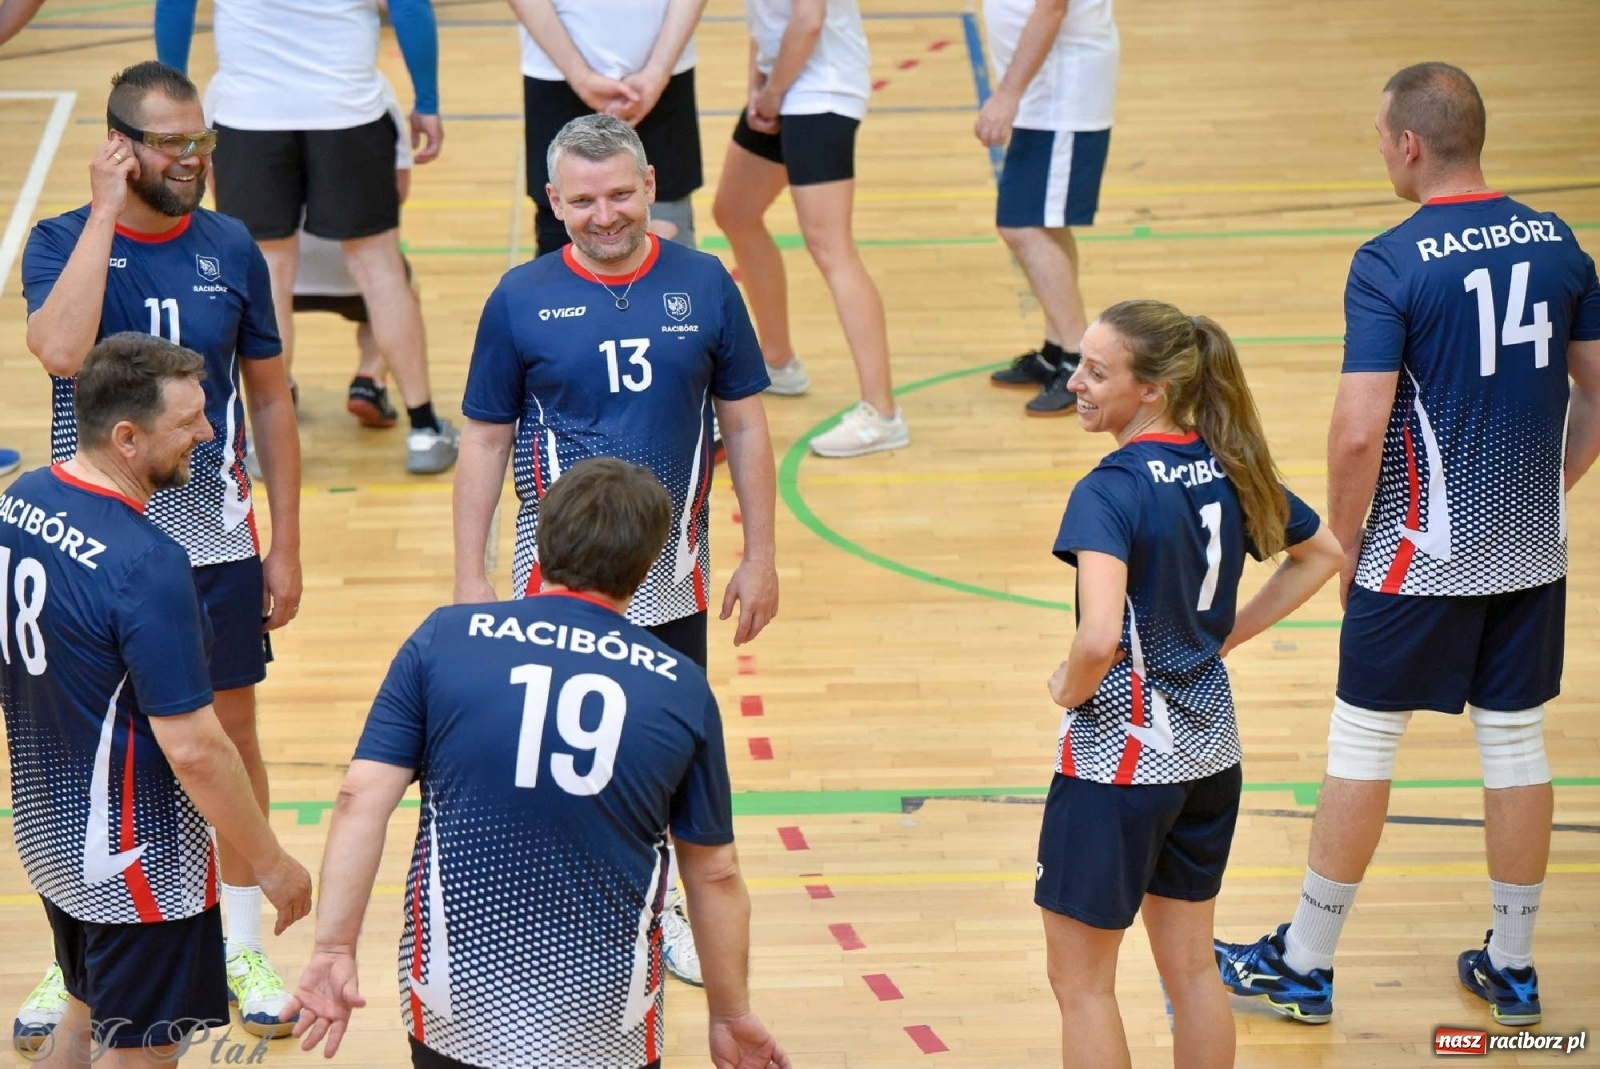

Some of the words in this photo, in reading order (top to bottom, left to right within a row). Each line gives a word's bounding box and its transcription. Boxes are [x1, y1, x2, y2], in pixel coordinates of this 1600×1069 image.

[109, 258, 127, 268] GO
[1416, 214, 1562, 262] RACIBÓRZ
[144, 298, 180, 346] 11
[661, 323, 699, 332] RACIBÓRZ
[1463, 261, 1552, 377] 14
[599, 338, 652, 393] 13
[1197, 501, 1222, 612] 1
[468, 613, 678, 682] RACIBÓRZ
[510, 663, 627, 796] 19
